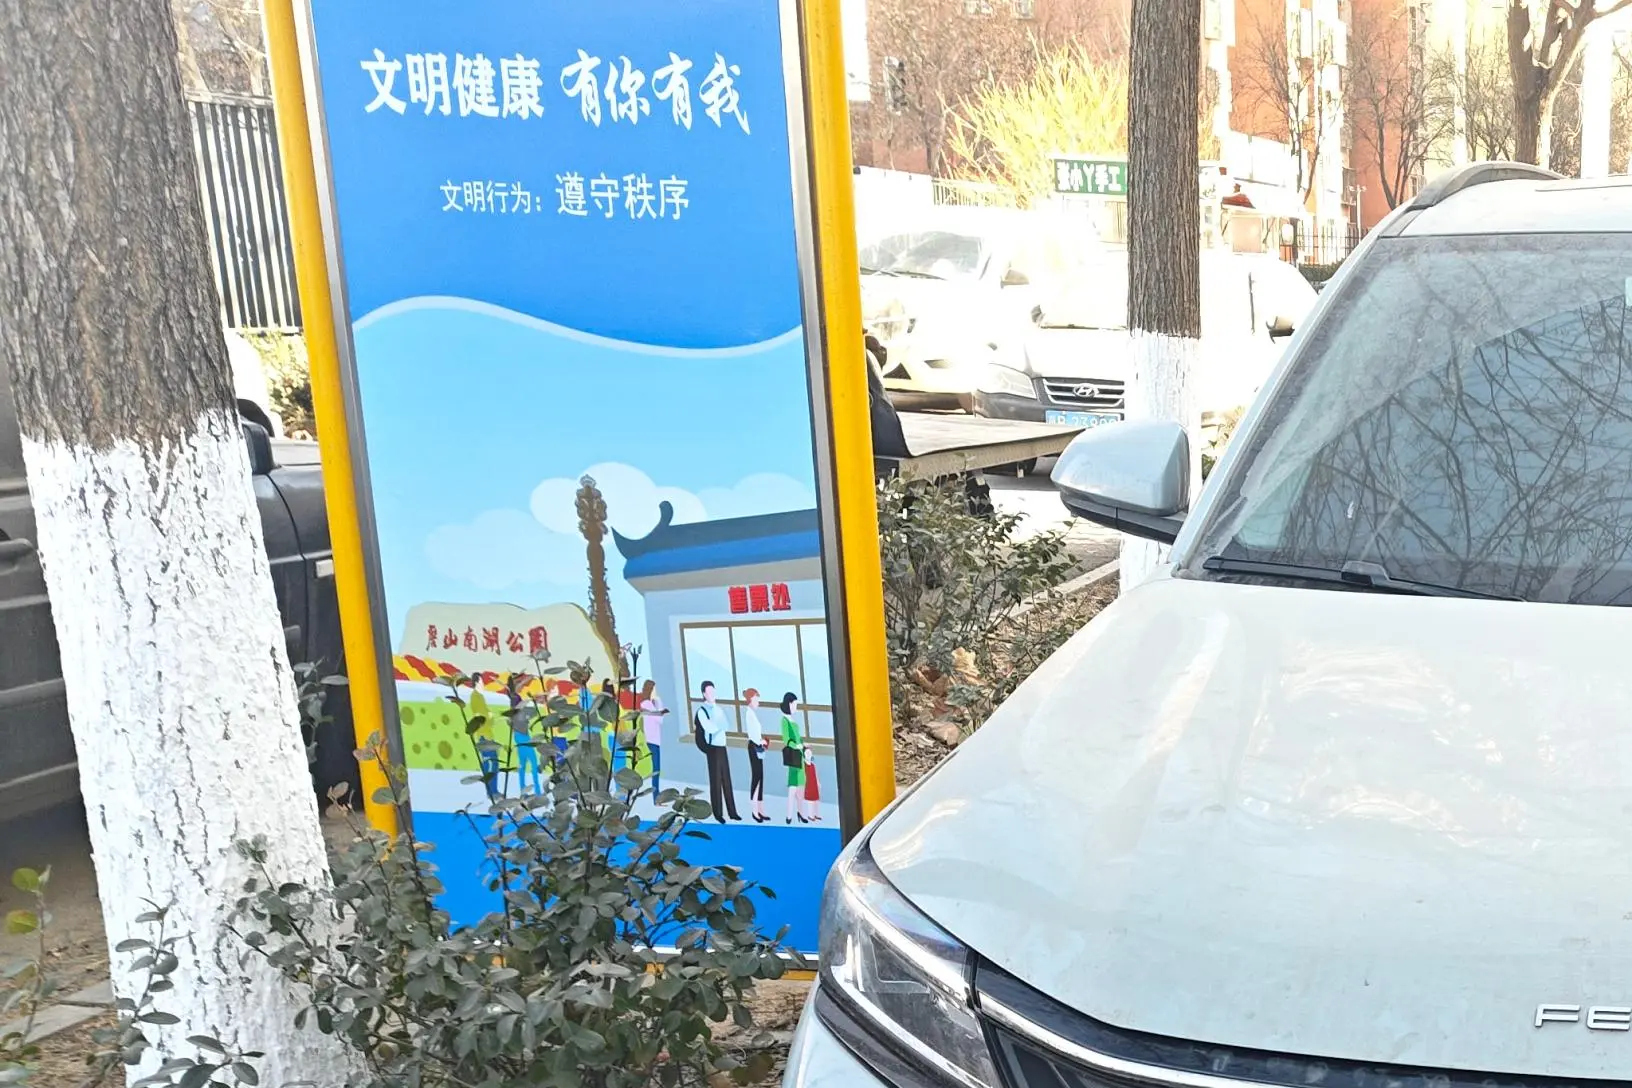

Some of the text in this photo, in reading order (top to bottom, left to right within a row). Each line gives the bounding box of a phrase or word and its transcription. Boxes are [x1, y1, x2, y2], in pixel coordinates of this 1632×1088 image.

[360, 48, 751, 135] 文明健康 有你有我
[555, 171, 690, 220] 遵守秩序
[728, 583, 791, 614] 售票处
